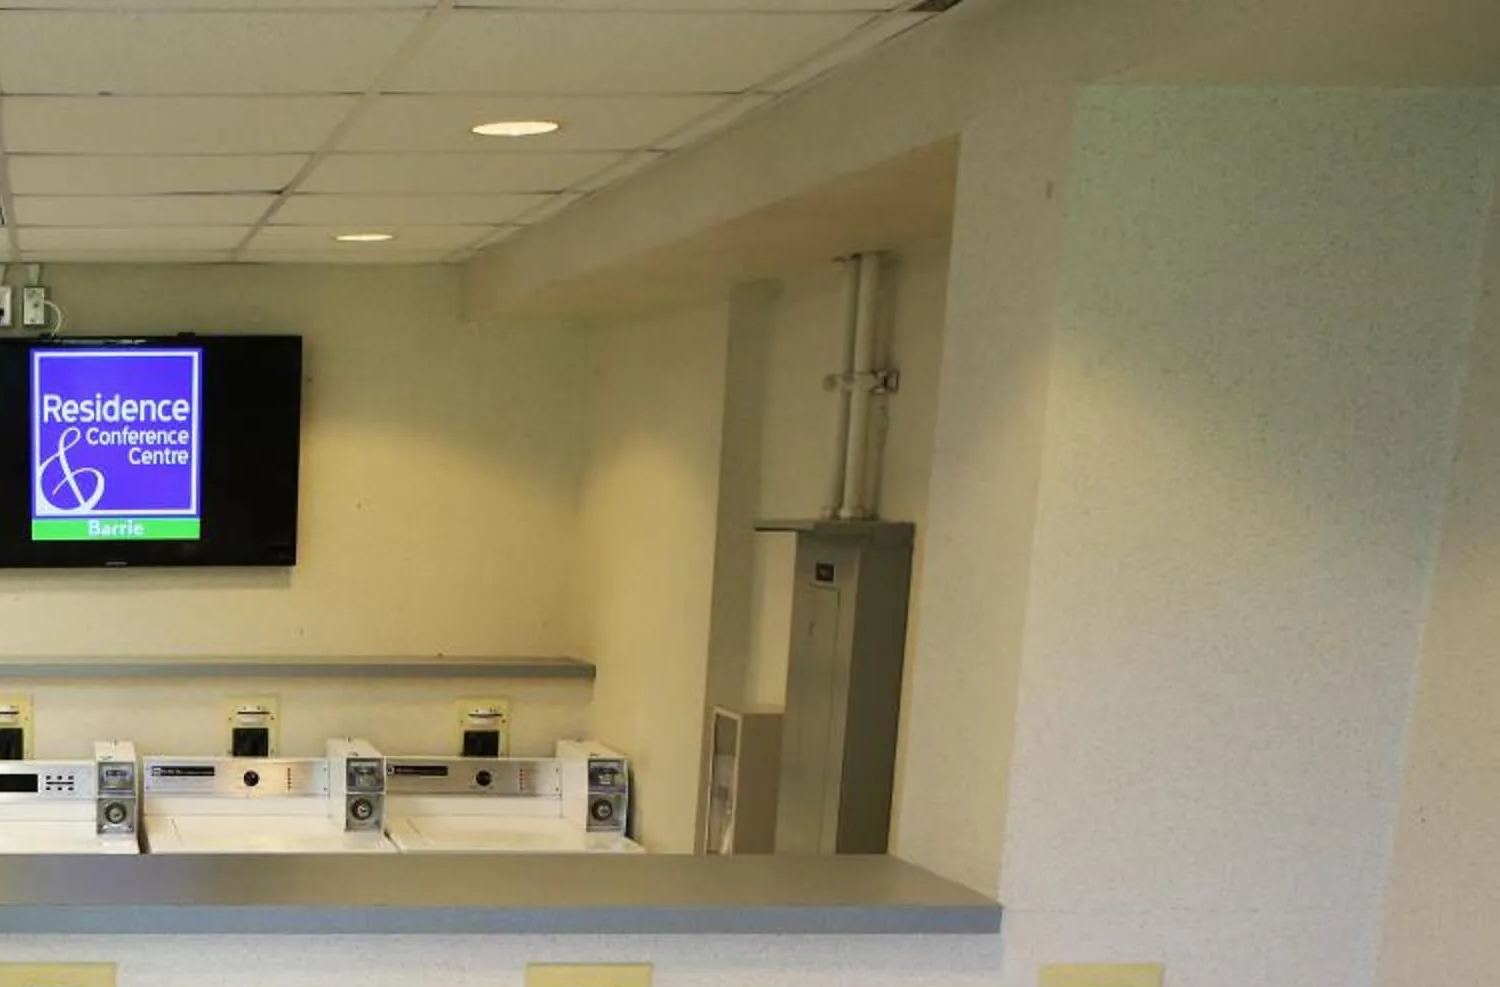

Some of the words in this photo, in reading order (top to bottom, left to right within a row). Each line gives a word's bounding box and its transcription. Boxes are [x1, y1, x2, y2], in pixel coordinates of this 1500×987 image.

[43, 392, 191, 423] Residence
[128, 447, 190, 465] Centre
[40, 426, 105, 513] &
[85, 425, 190, 446] Conference
[88, 519, 145, 537] Barrie
